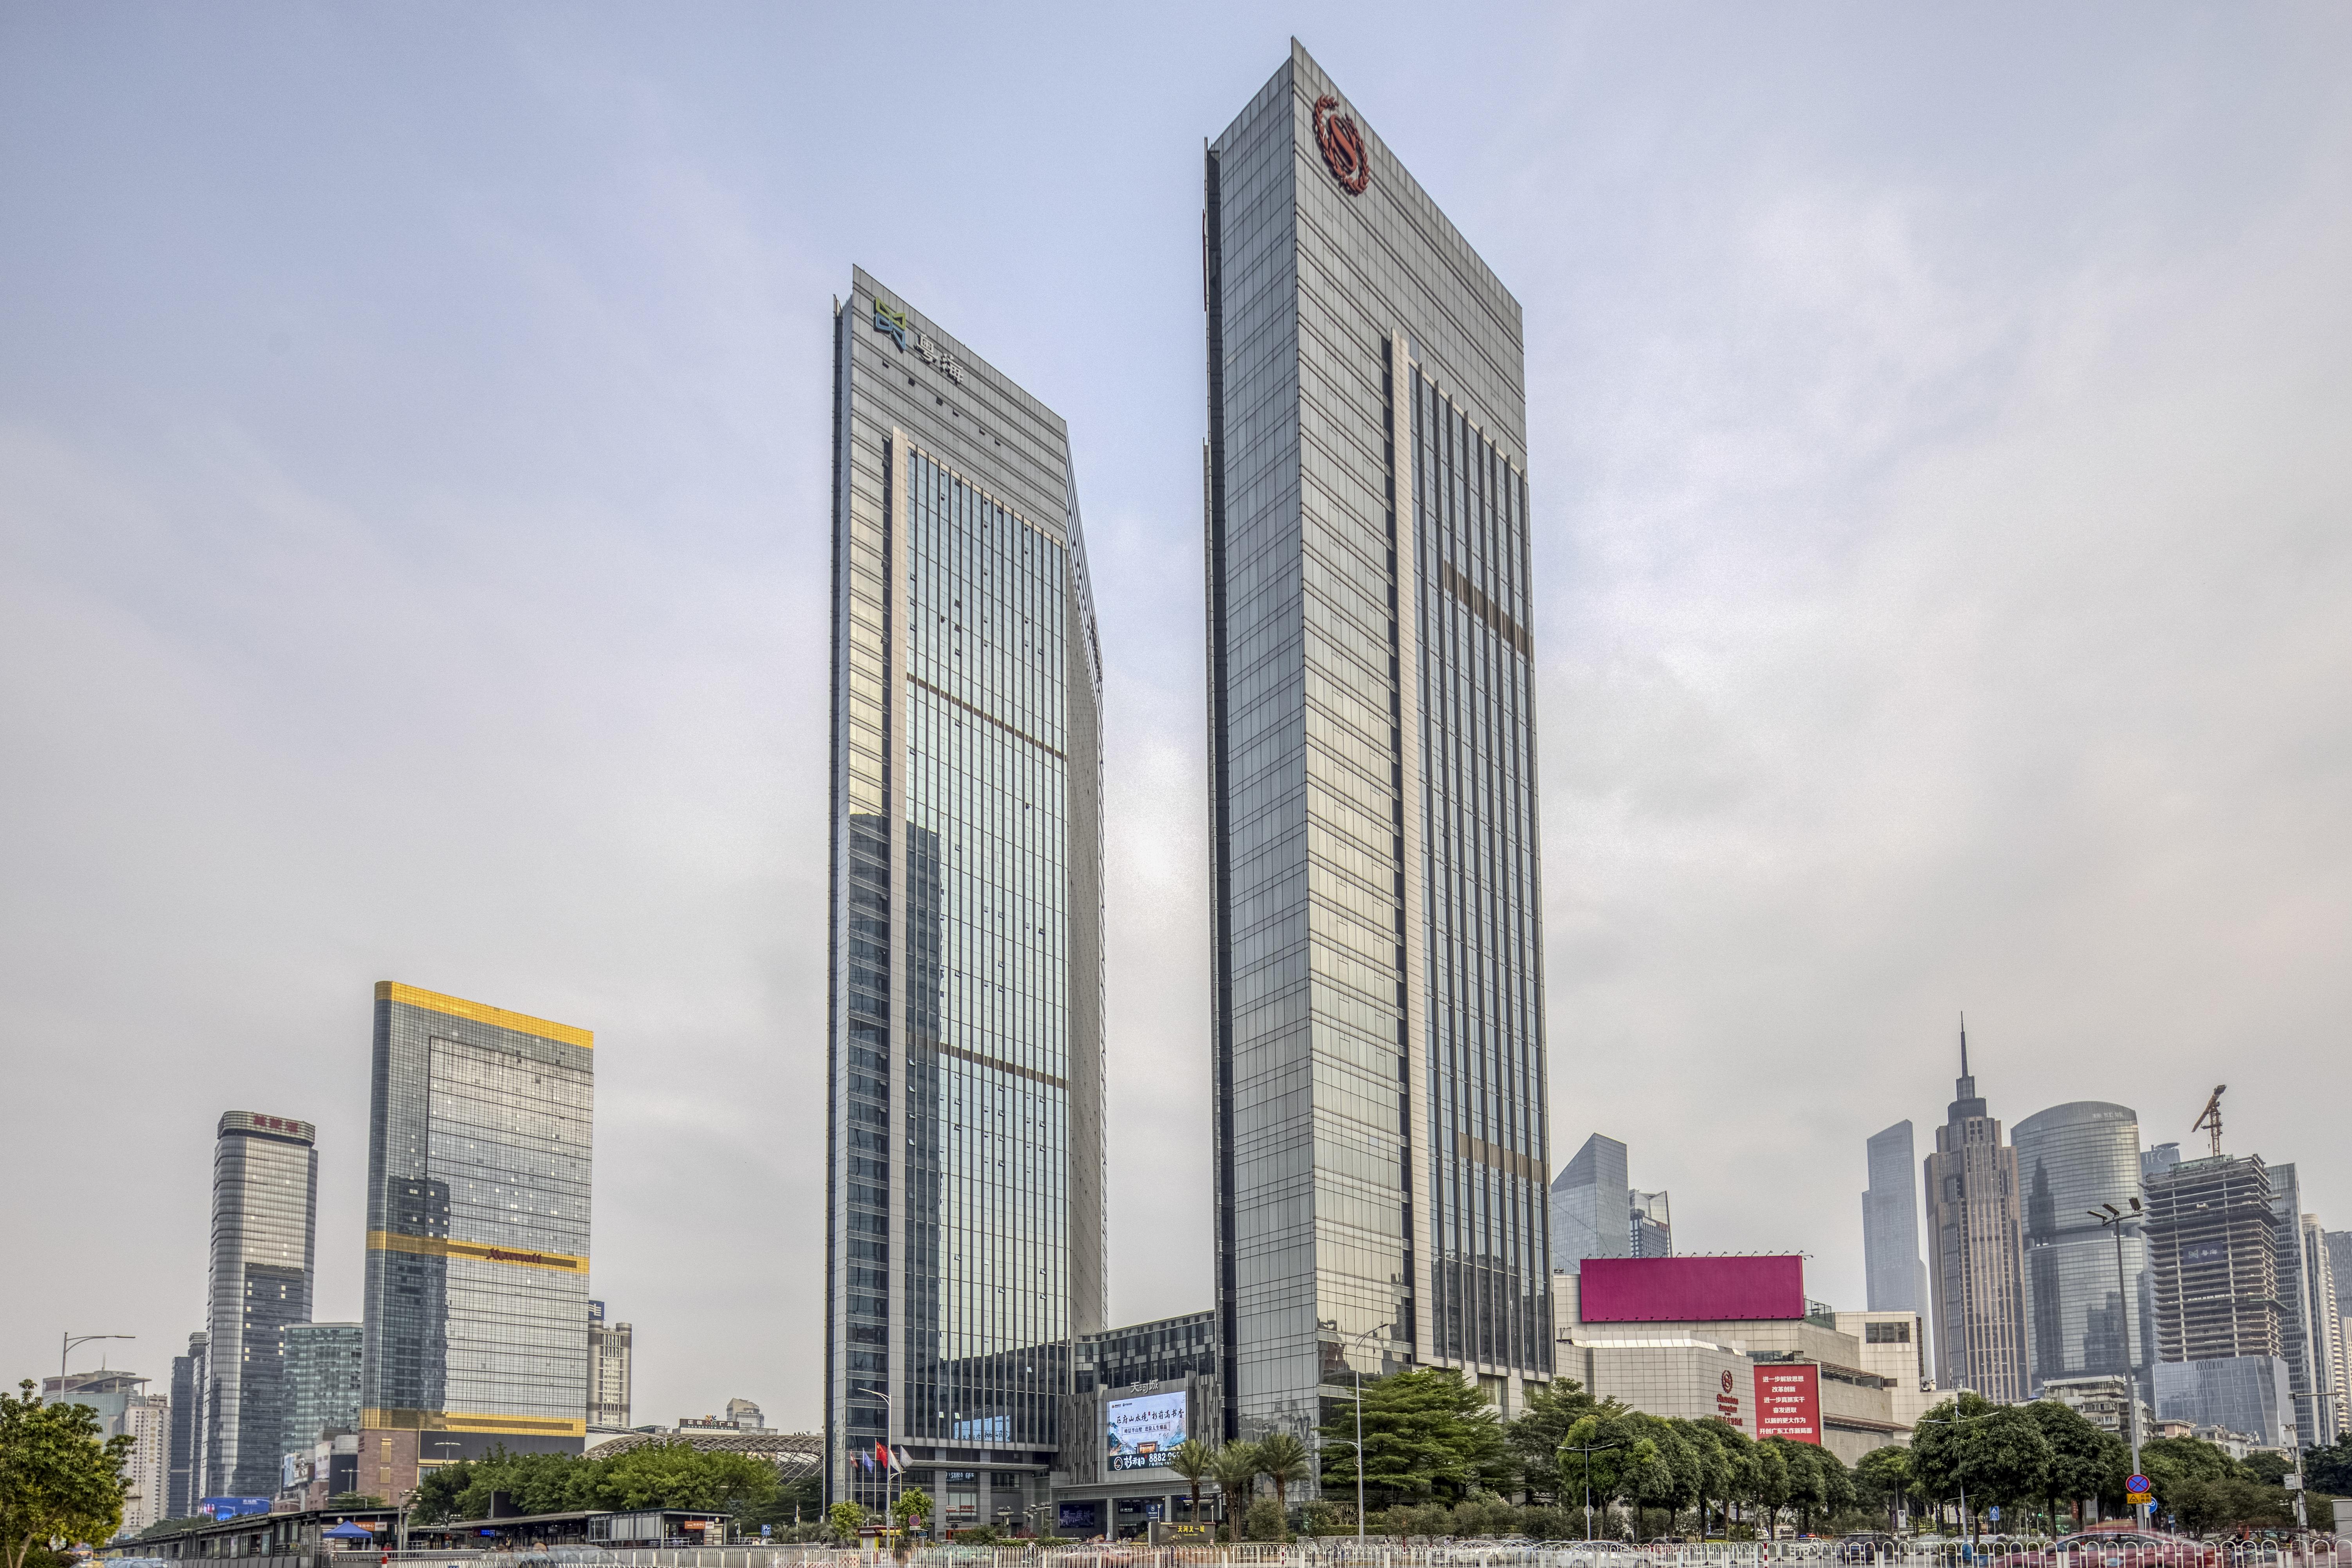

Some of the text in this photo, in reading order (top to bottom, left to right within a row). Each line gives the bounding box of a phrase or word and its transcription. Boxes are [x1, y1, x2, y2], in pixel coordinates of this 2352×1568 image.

[916, 333, 964, 384] 粤海
[2146, 1152, 2164, 1164] IFC
[486, 1248, 541, 1263] Marriott
[1130, 1379, 1159, 1393] 天河城
[1717, 1393, 1739, 1405] Sheraton
[1149, 1453, 1166, 1462] 8882
